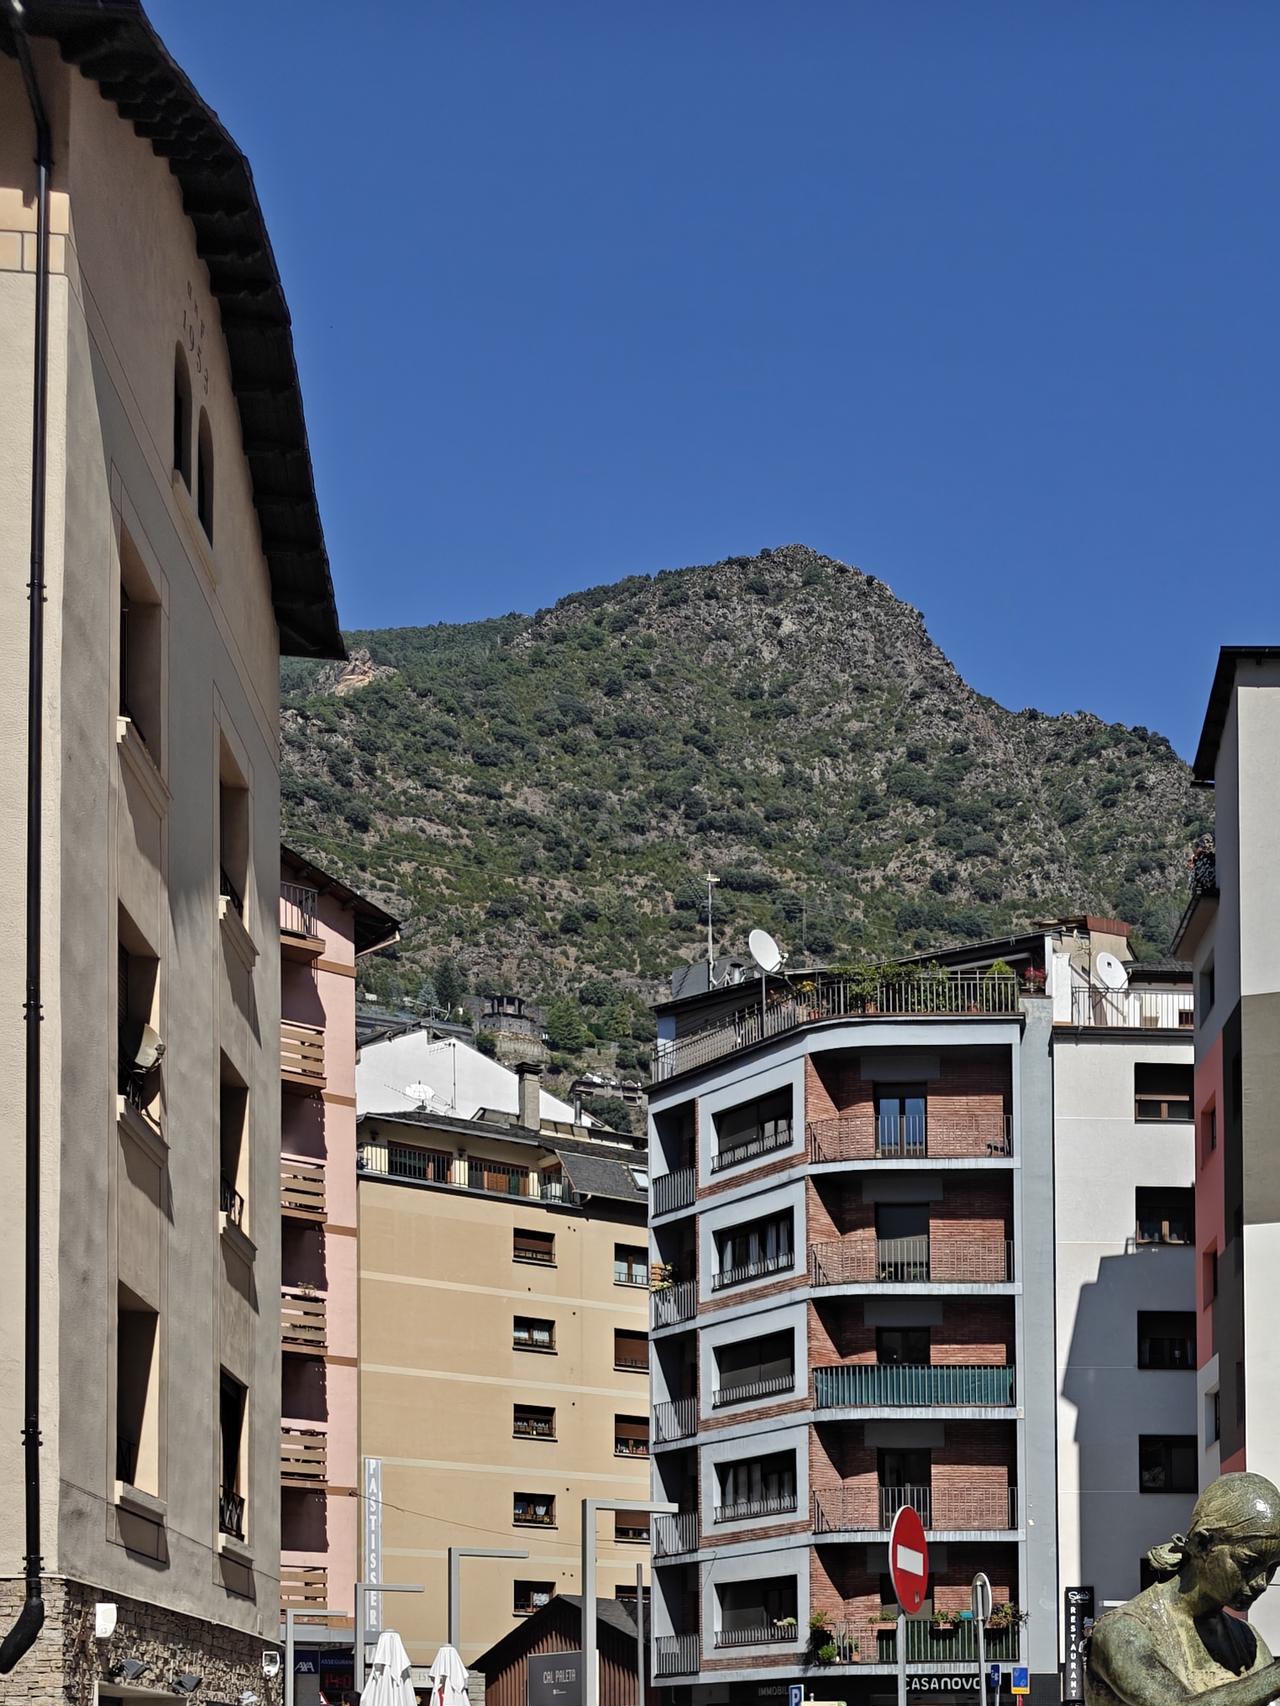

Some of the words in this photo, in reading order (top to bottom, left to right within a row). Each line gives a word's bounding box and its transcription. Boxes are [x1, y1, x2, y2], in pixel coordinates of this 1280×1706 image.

[183, 309, 209, 395] 1953
[368, 1459, 379, 1632] PASTISSER
[295, 1661, 315, 1672] AXA
[325, 1673, 353, 1689] 14:0
[543, 1670, 554, 1684] CAL
[555, 1669, 576, 1683] PALETA
